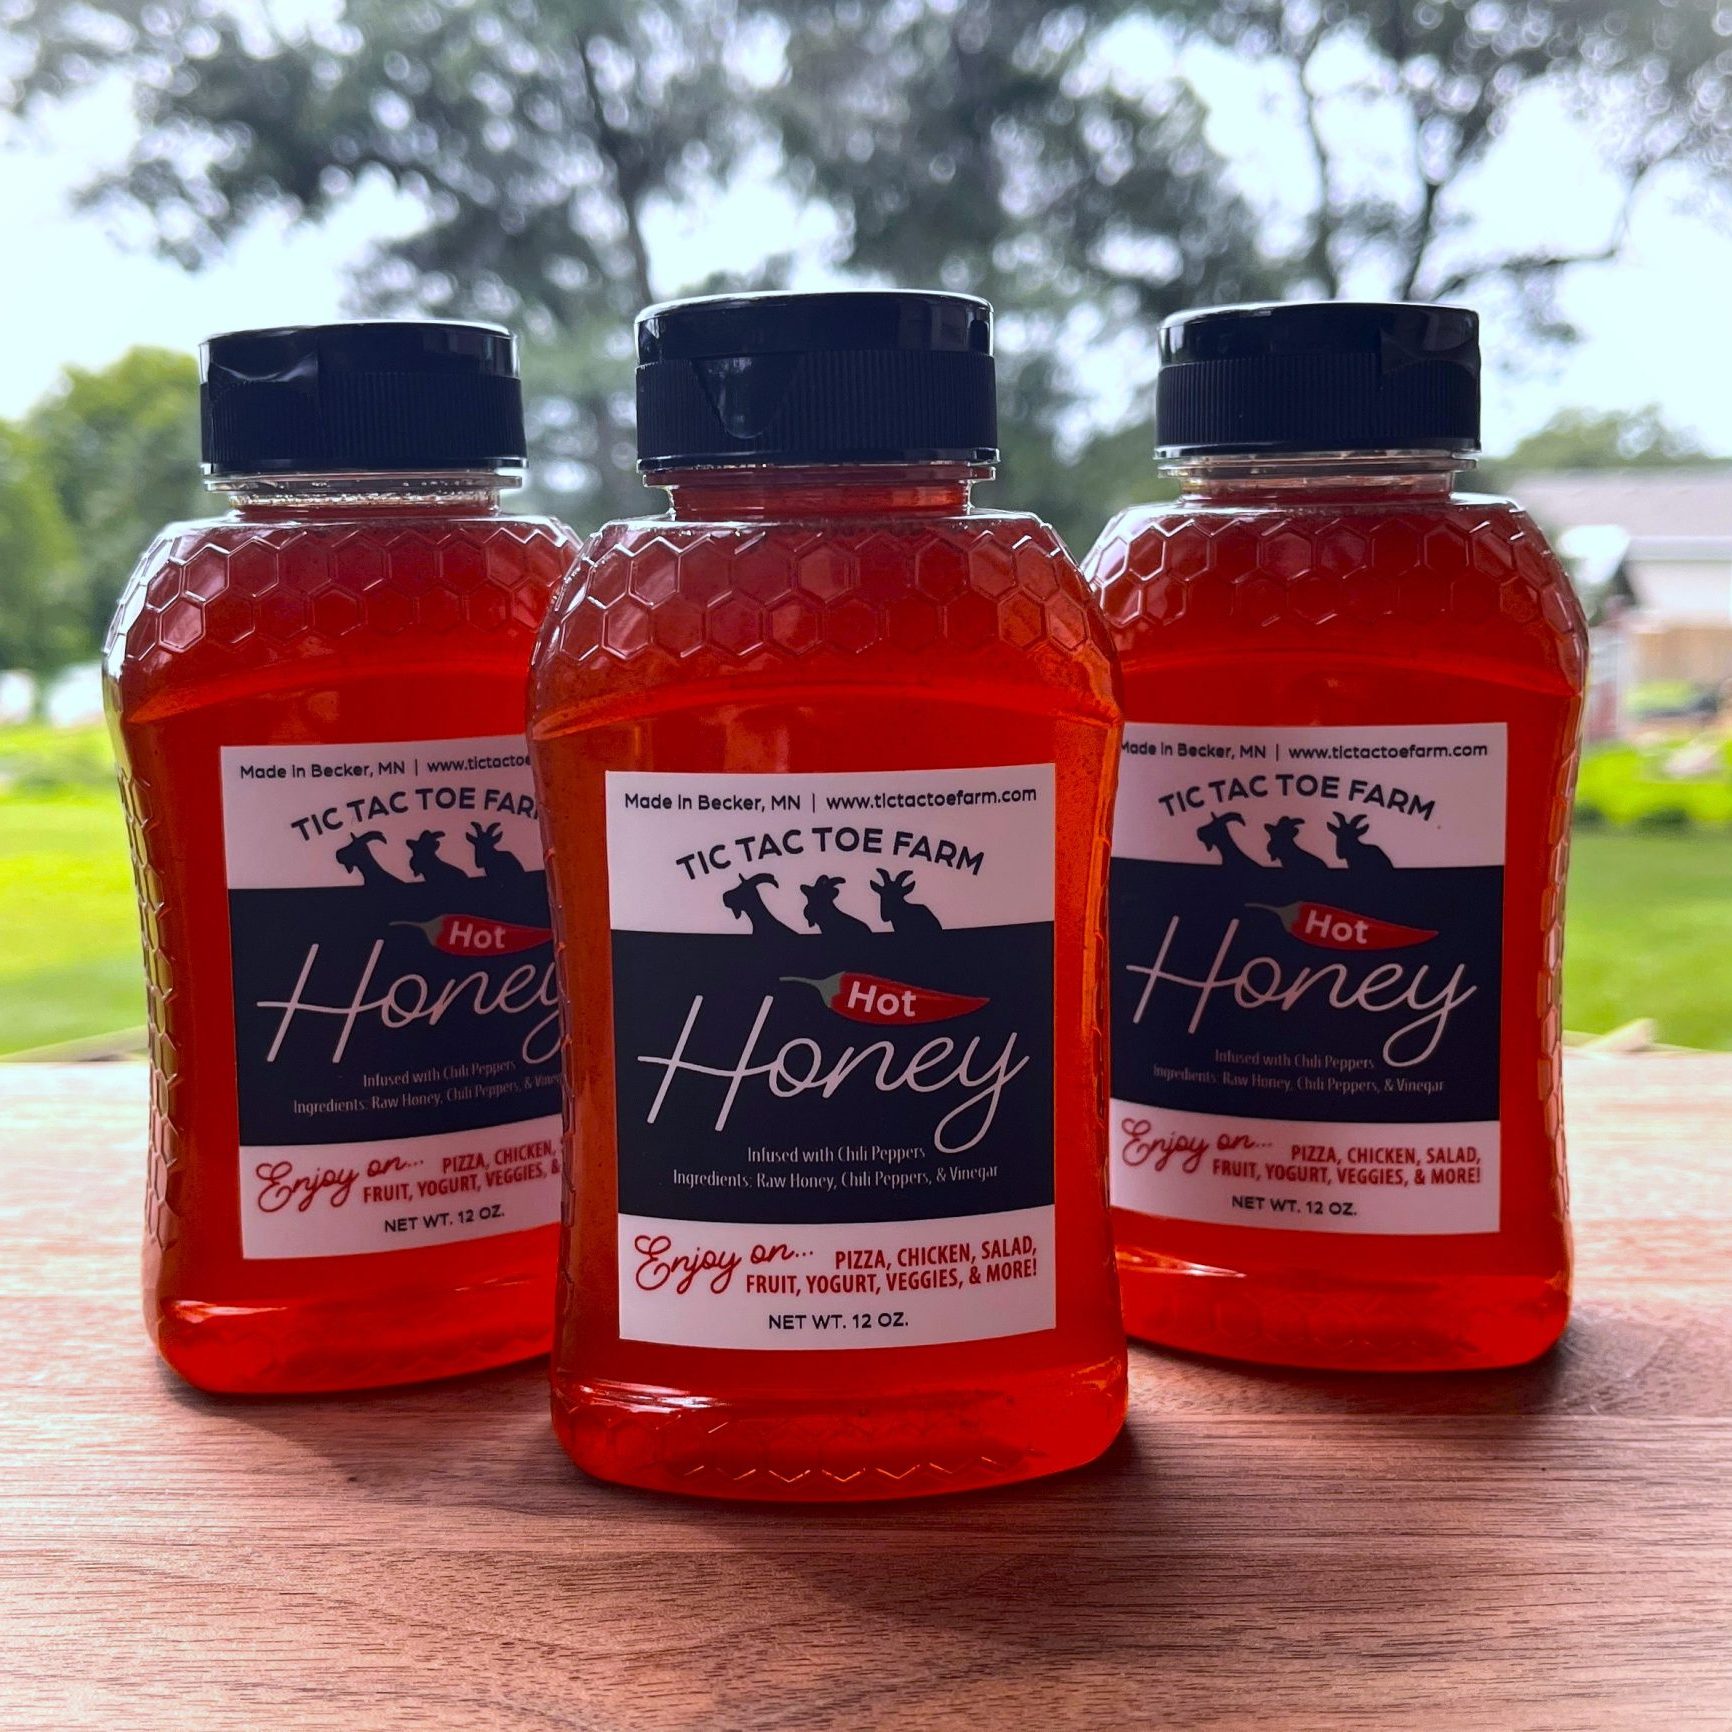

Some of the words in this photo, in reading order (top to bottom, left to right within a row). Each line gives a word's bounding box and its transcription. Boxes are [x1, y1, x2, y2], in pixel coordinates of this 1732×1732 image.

[1177, 743, 1235, 761] Becker,
[1240, 745, 1267, 759] MN
[1289, 743, 1488, 760] www.tictactoefarm.com
[240, 764, 286, 779] Made
[311, 763, 374, 778] Becker,
[378, 761, 405, 775] MN
[624, 792, 673, 810] Made
[698, 795, 766, 813] Becker,
[771, 795, 801, 810] MN
[826, 787, 1037, 810] www.tictactoefarm.com
[1158, 786, 1206, 817] TIC
[1208, 775, 1269, 803] TAC
[1275, 774, 1339, 799] TOE
[1347, 780, 1436, 822] FARM
[290, 808, 344, 841] TIC
[346, 792, 409, 823] TAC
[415, 787, 476, 810] TOE
[483, 788, 539, 820] FAR
[676, 844, 732, 881] TIC
[735, 830, 804, 863] TAC
[811, 827, 883, 853] TOE
[892, 831, 985, 877] FARM
[449, 921, 505, 949] Hot
[1304, 909, 1369, 945] Hot
[847, 980, 917, 1019] Hot
[1126, 915, 1477, 1068] Honey
[363, 1072, 410, 1088] Infused
[412, 1069, 441, 1083] with
[443, 1064, 470, 1080] Chili
[471, 1060, 516, 1078] Peppers
[637, 994, 1030, 1154] Honey
[1215, 1049, 1261, 1066] Infused
[1263, 1052, 1292, 1068] with
[1295, 1053, 1322, 1068] Chili
[1324, 1054, 1374, 1072] Peppers
[1222, 1074, 1249, 1087] Raw
[1296, 1076, 1325, 1091] Chili
[1383, 1077, 1394, 1092] &
[1396, 1078, 1444, 1095] Vinegar
[371, 1095, 399, 1110] Raw
[747, 1146, 799, 1163] Infused
[802, 1146, 834, 1163] with
[837, 1145, 868, 1163] Chili
[871, 1145, 926, 1166] Peppers
[1121, 1117, 1209, 1174] Enjoy
[1291, 1144, 1342, 1164] PIZZA,
[1347, 1146, 1420, 1165] CHICKEN,
[1426, 1146, 1481, 1165] SALAD,
[256, 1161, 359, 1213] Enjoy
[442, 1152, 489, 1174] PIZZA,
[495, 1139, 556, 1166] CHICKEN,
[363, 1183, 414, 1204] FRUIT,
[417, 1174, 481, 1198] YOGURT,
[485, 1164, 548, 1188] VEGGIES,
[673, 1169, 753, 1189] Ingredients:
[756, 1172, 787, 1189] Raw
[790, 1172, 837, 1192] Honey,
[841, 1170, 872, 1188] Chili
[874, 1169, 932, 1189] Peppers,
[936, 1167, 947, 1182] &
[948, 1163, 998, 1185] Vinegar
[1212, 1158, 1261, 1182] FRUIT,
[1265, 1163, 1332, 1186] YOGURT,
[1337, 1168, 1409, 1187] VEGGIES,
[1414, 1169, 1425, 1184] &
[1431, 1169, 1481, 1184] MORE!
[385, 1217, 418, 1233] NET
[423, 1213, 452, 1229] WT.
[458, 1209, 474, 1223] 12
[479, 1204, 505, 1221] OZ.
[1232, 1195, 1265, 1210] NET
[1270, 1197, 1301, 1213] WT.
[1305, 1200, 1323, 1215] 12
[1329, 1200, 1357, 1217] OZ.
[634, 1234, 742, 1295] Enjoy
[835, 1249, 892, 1270] PIZZA,
[897, 1240, 976, 1267] CHICKEN,
[981, 1234, 1037, 1262] SALAD,
[746, 1274, 801, 1296] FRUIT,
[806, 1274, 881, 1294] YOGURT,
[886, 1266, 963, 1292] VEGGIES,
[968, 1267, 981, 1284] &
[986, 1258, 1038, 1283] MORE!
[768, 1314, 807, 1330] NET
[811, 1314, 847, 1329] WT.
[853, 1314, 872, 1329] 12
[877, 1312, 909, 1328] OZ.
